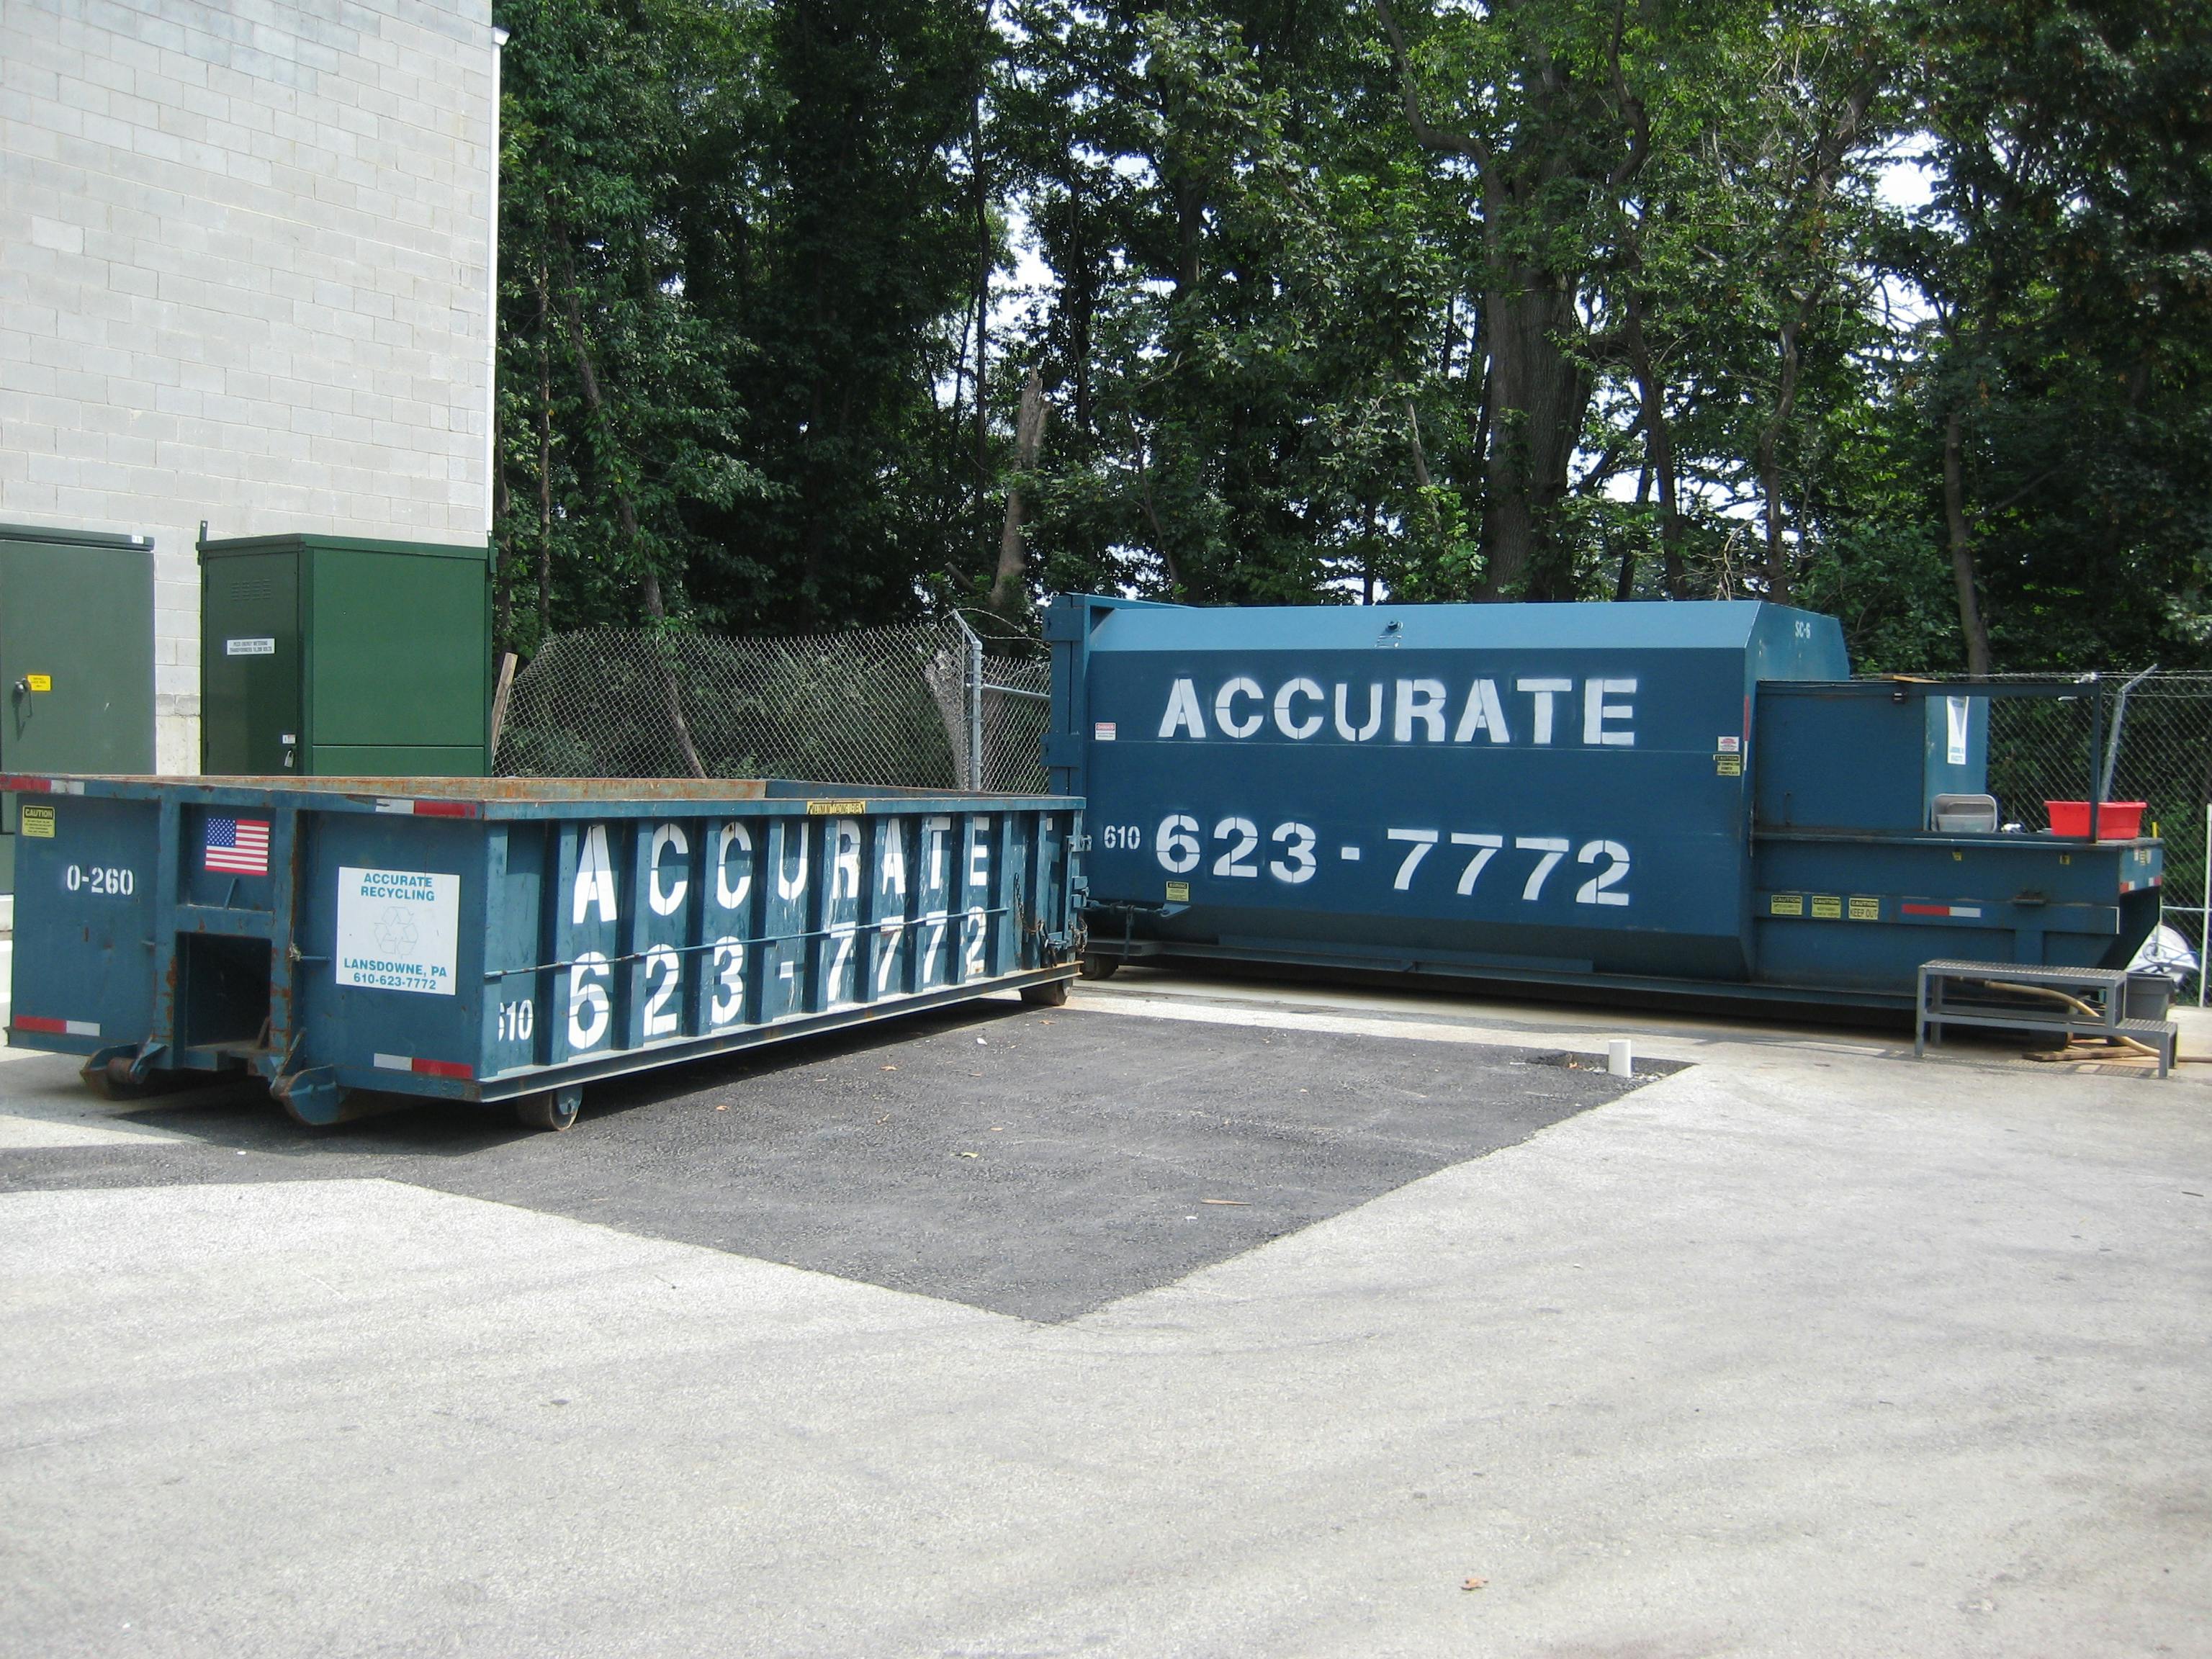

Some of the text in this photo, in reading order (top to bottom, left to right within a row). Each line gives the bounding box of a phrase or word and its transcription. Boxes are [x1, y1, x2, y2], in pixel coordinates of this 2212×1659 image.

[1158, 678, 1637, 746] ACCURATE
[25, 808, 53, 818] CAUTION
[1104, 825, 1141, 850] 610
[573, 817, 989, 924] ACCURATE
[364, 873, 433, 887] ACCURATE
[361, 886, 435, 901] RECYCLING
[344, 958, 447, 977] LANSDOWNE, PA
[354, 972, 436, 989] 610-623-7772
